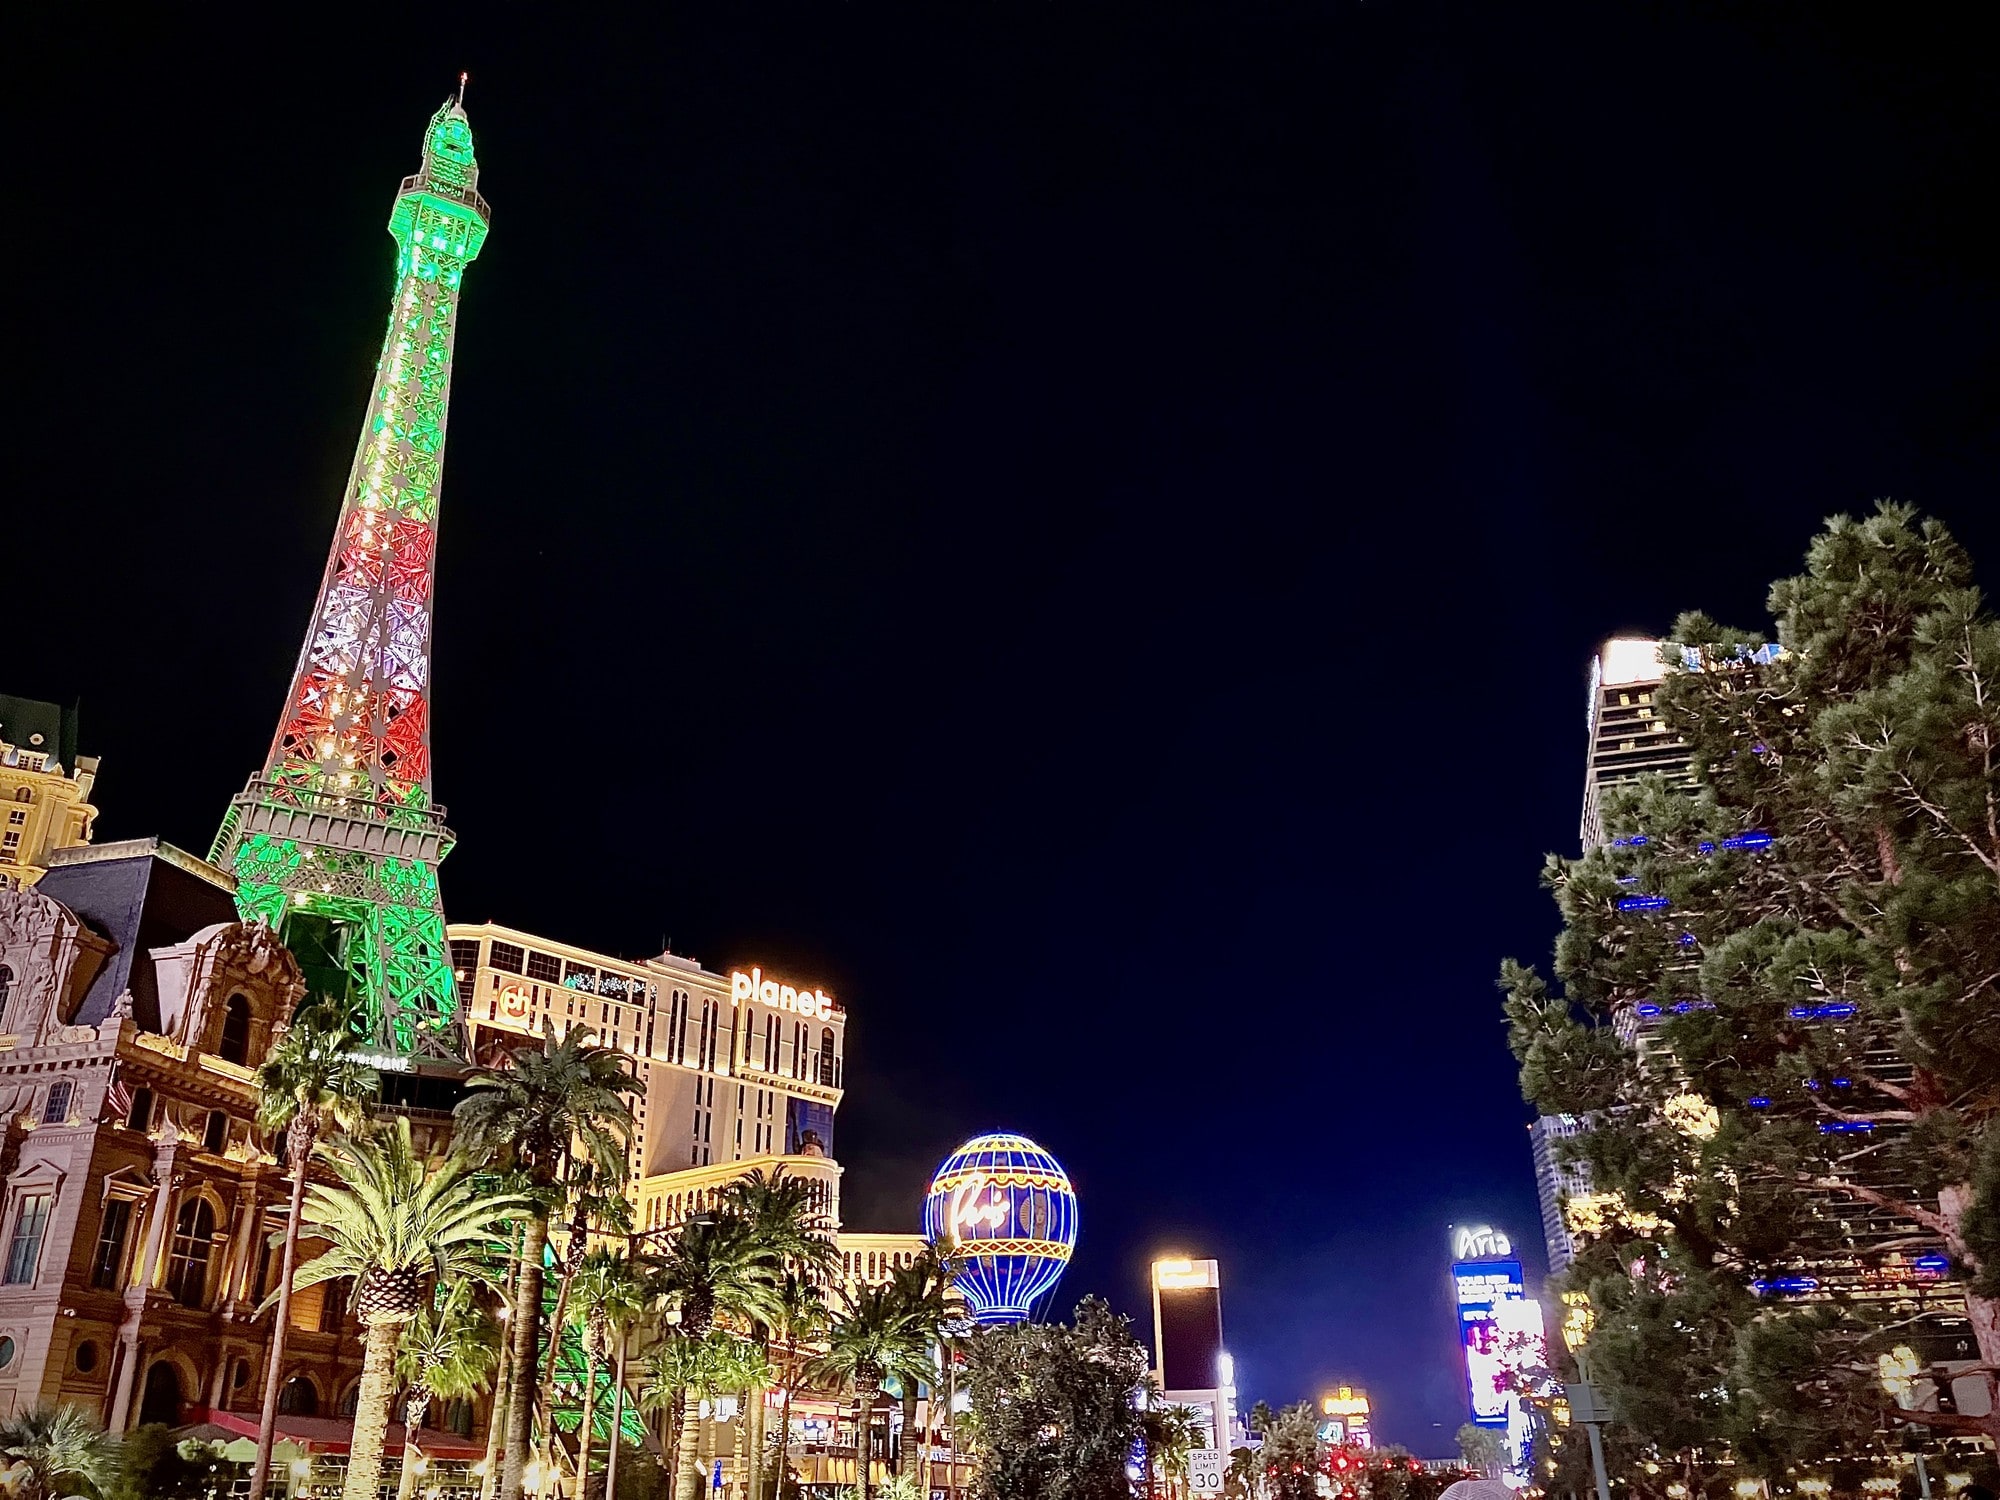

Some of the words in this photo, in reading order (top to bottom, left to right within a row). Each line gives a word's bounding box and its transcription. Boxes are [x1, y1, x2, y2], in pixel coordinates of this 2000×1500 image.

[731, 967, 832, 1022] planet
[1458, 1225, 1512, 1260] Aria
[1195, 1462, 1217, 1470] LIMIT
[1195, 1472, 1219, 1488] 30
